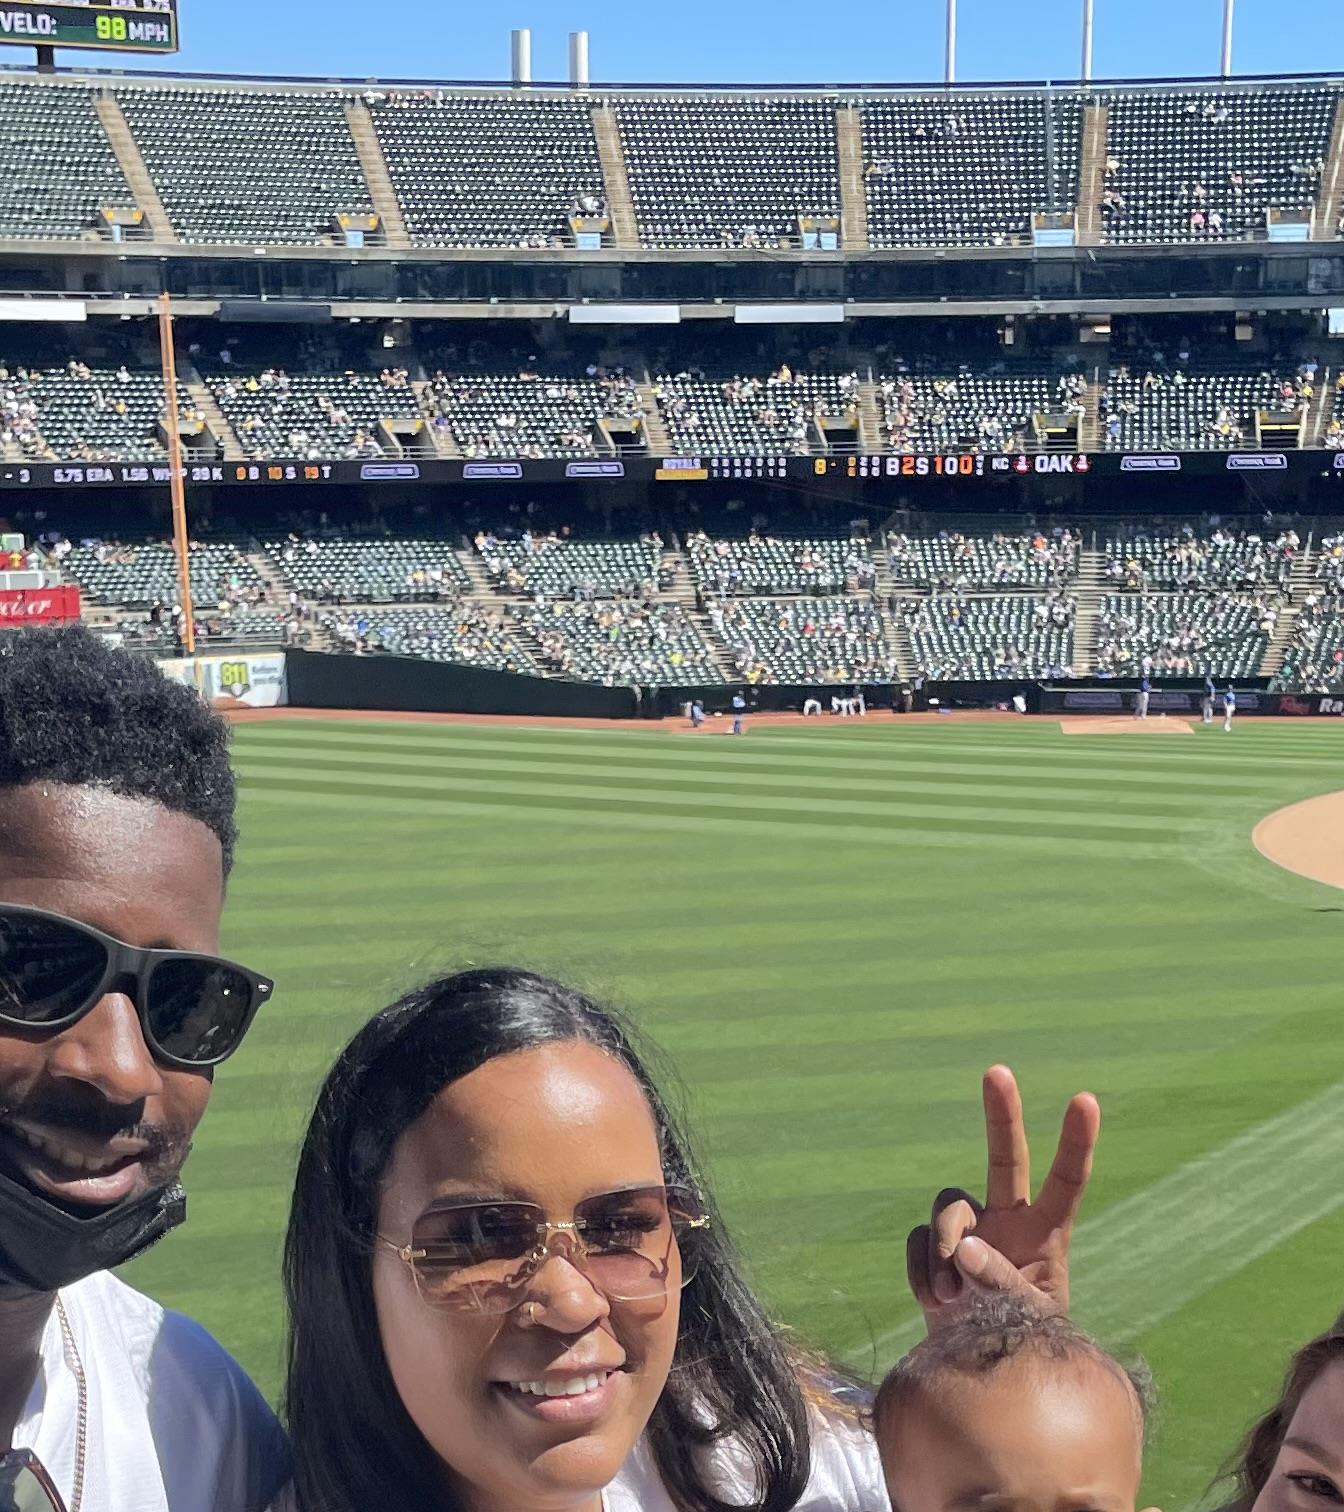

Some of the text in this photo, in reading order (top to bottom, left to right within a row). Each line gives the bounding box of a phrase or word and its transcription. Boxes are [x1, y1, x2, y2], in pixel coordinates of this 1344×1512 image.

[95, 15, 169, 41] 98 MPH
[152, 467, 188, 481] WHP
[1034, 454, 1074, 473] OAK
[220, 661, 249, 686] 811
